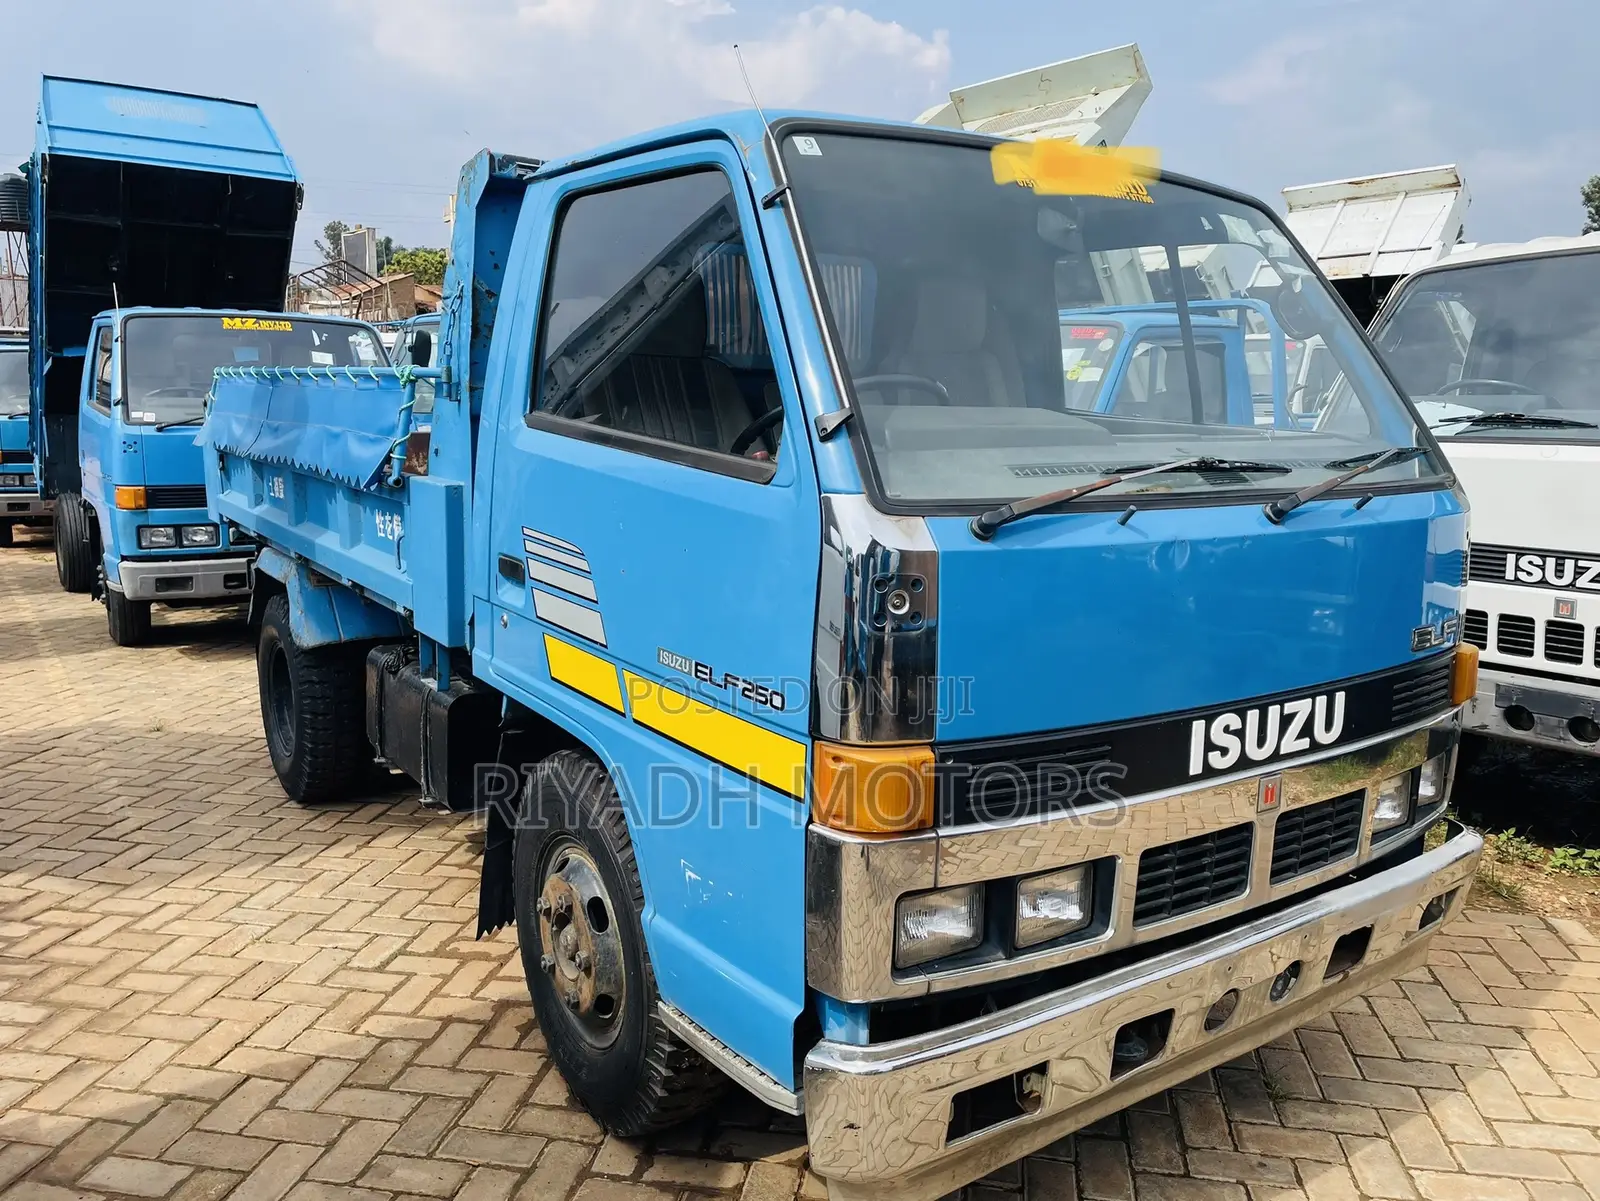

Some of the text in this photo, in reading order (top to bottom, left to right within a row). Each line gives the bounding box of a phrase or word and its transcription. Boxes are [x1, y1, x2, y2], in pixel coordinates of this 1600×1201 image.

[221, 317, 259, 328] MZ
[659, 649, 690, 673] ISUZU
[1189, 691, 1346, 776] ISUZU
